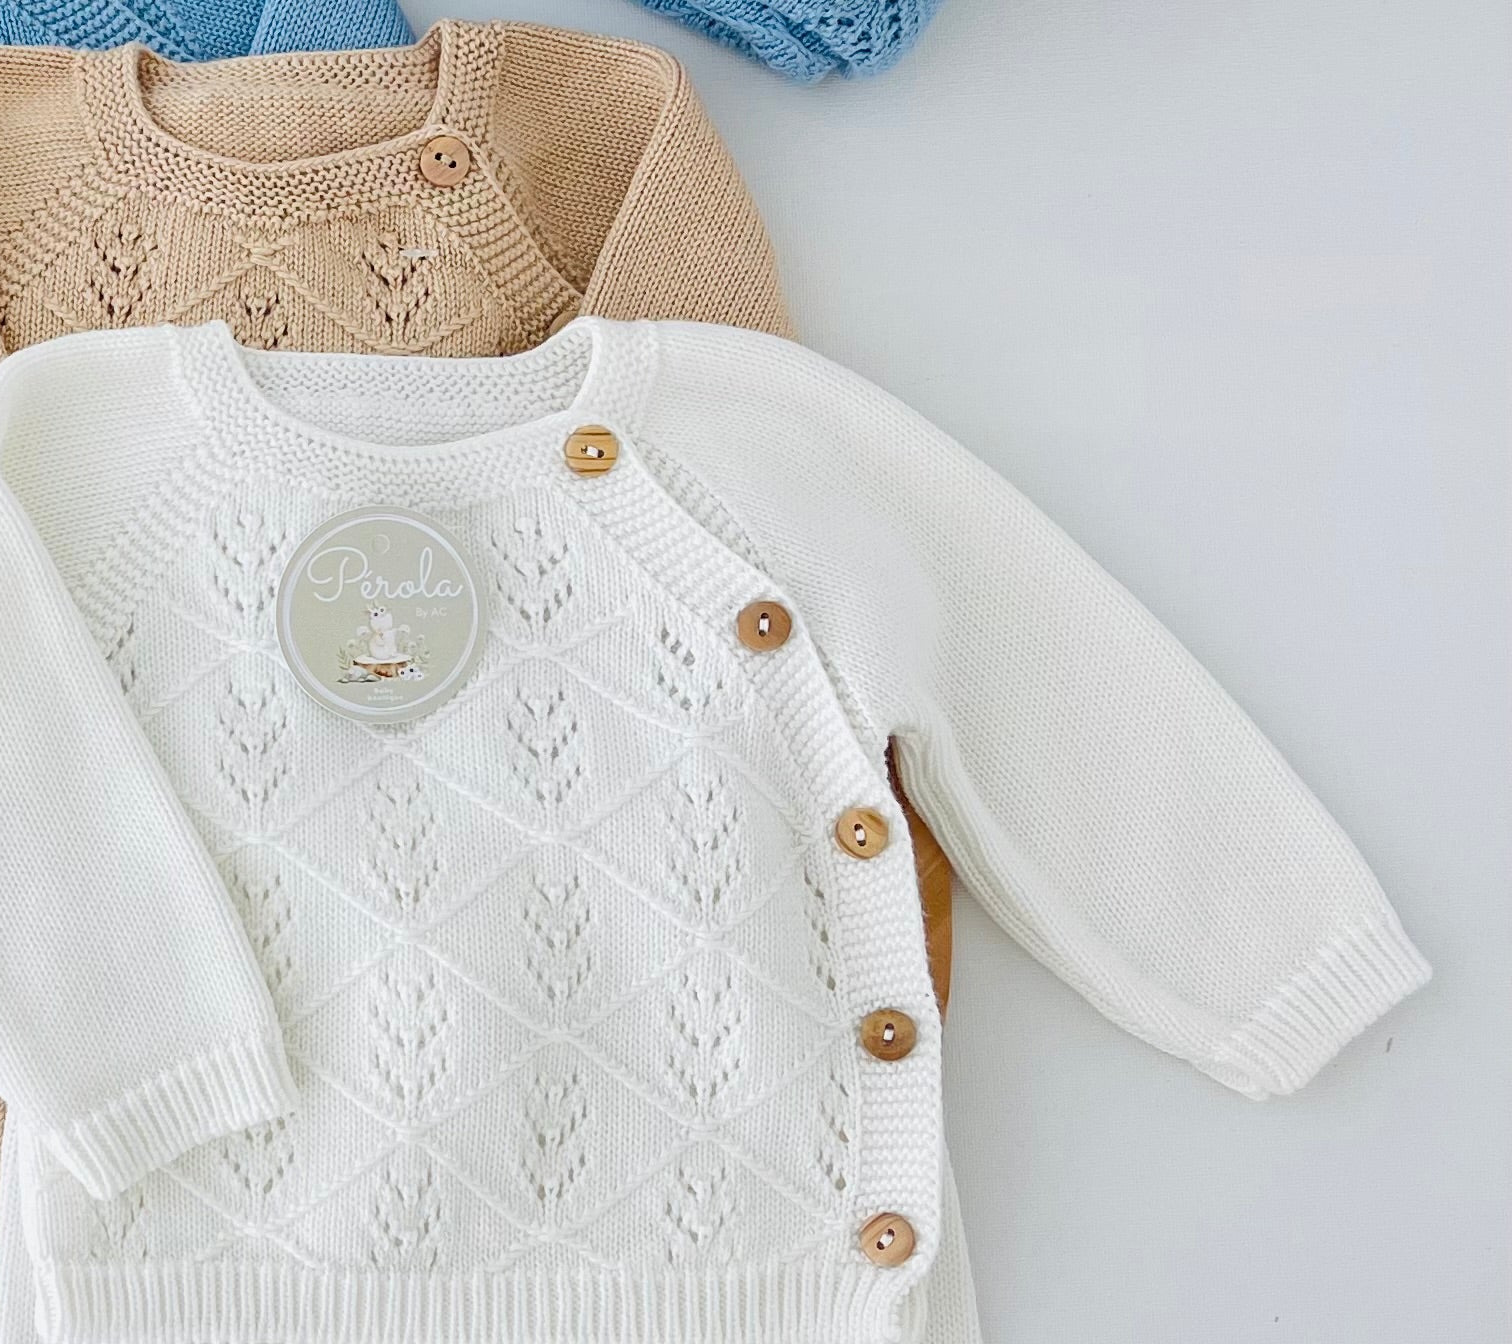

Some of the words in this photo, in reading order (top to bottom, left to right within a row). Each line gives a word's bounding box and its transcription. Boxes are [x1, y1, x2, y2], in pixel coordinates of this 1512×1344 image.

[307, 546, 464, 602] Pérola
[415, 607, 428, 618] By
[430, 607, 448, 617] AC
